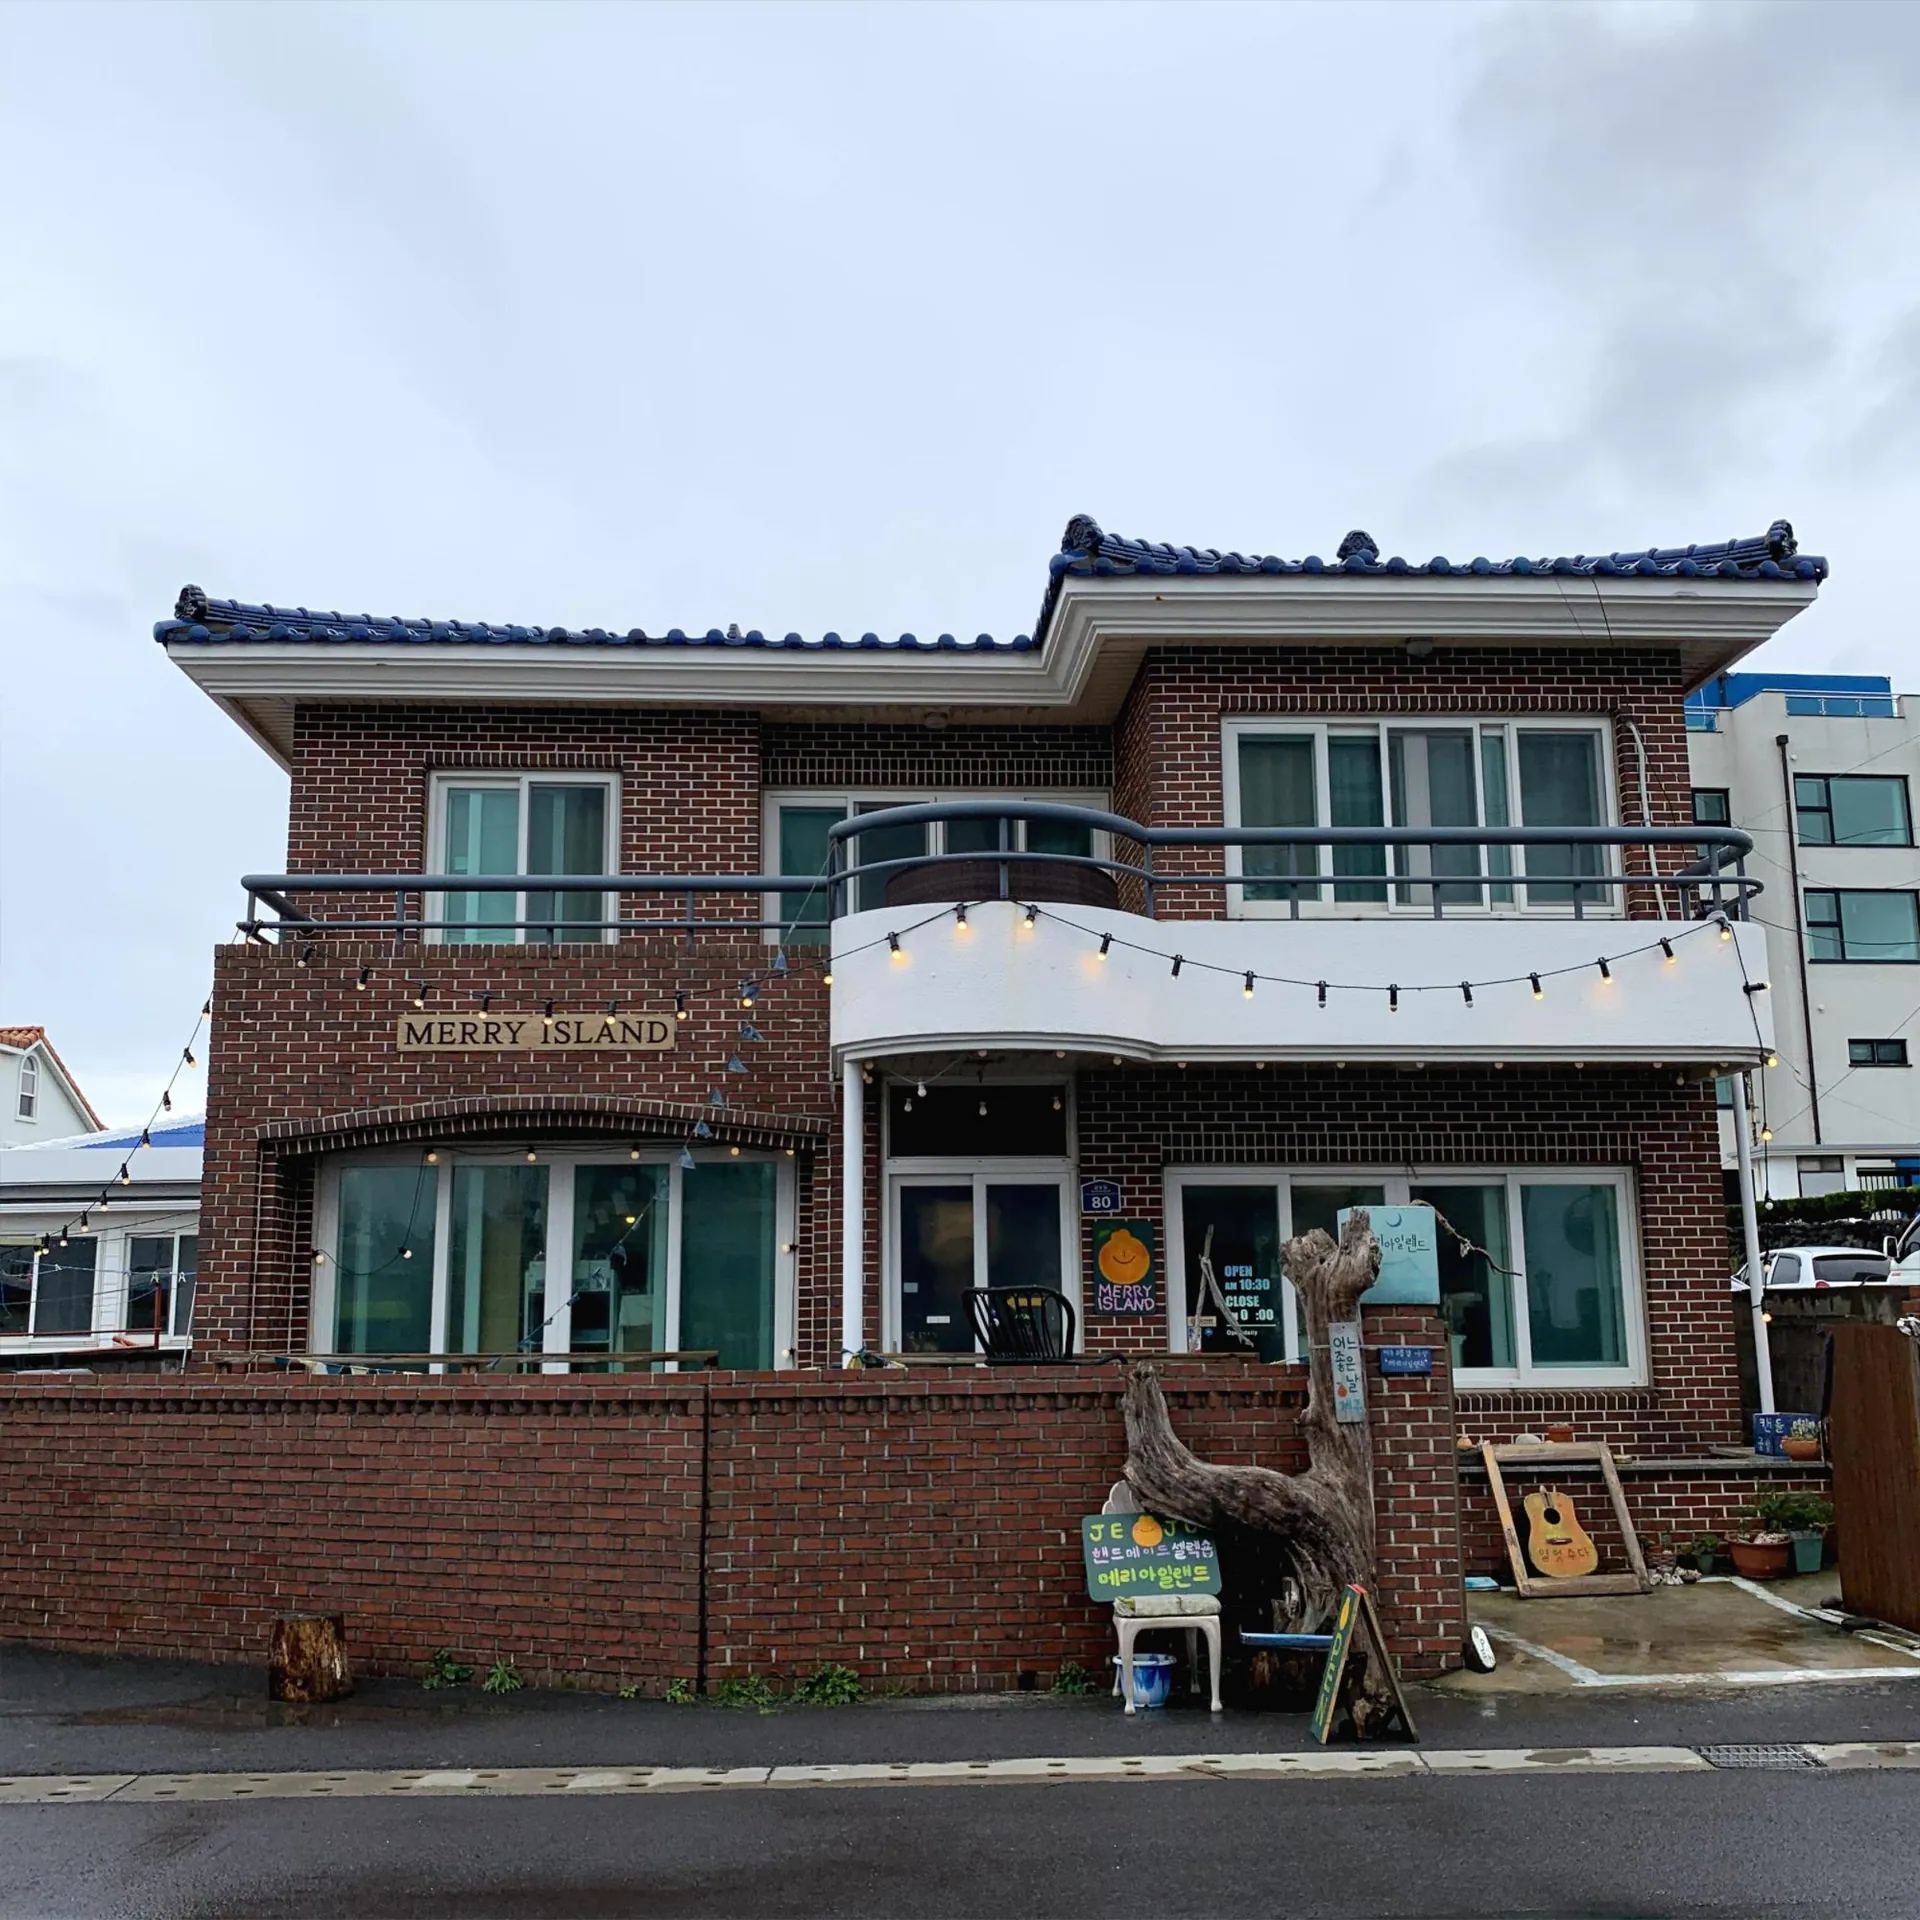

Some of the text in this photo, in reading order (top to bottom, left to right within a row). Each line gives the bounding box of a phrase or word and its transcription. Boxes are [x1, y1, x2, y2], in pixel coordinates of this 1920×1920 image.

[403, 1020, 669, 1045] MERRY ISLAND
[1091, 1196, 1111, 1209] 80
[1224, 1265, 1253, 1277] OPEN
[1098, 1283, 1152, 1299] MERRY
[1225, 1278, 1270, 1290] AM 10:30
[1097, 1296, 1155, 1311] ISLAND
[1225, 1295, 1260, 1307] CLOSE
[1346, 1374, 1358, 1393] 날
[1089, 1522, 1124, 1541] JE
[1092, 1545, 1170, 1564] 핸드메이드
[1098, 1564, 1210, 1589] 메리아일랜드
